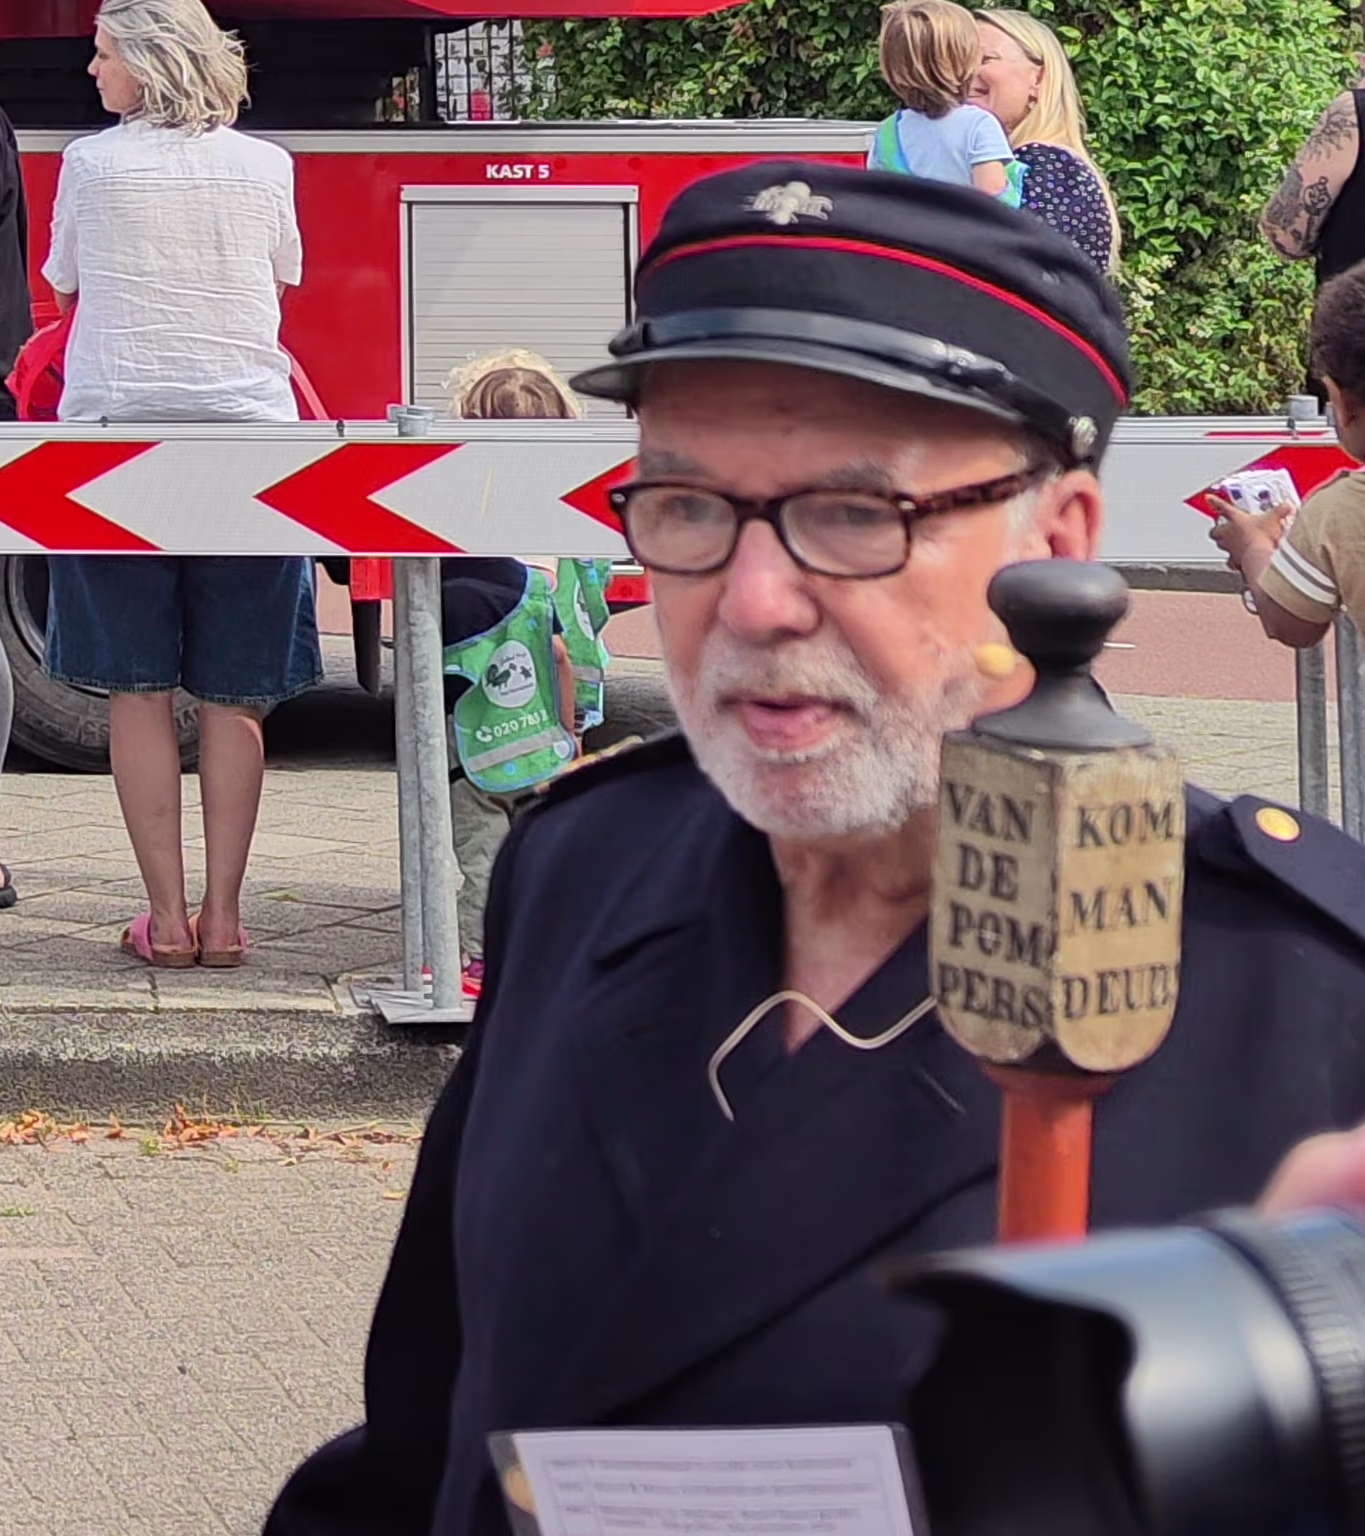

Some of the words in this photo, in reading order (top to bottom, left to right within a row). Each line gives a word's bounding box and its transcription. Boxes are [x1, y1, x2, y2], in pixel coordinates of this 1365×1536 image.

[486, 164, 534, 179] KAST
[538, 164, 550, 179] 5
[946, 782, 1034, 844] VAN
[1077, 799, 1175, 848] KOM
[959, 843, 1017, 902] DE
[1069, 876, 1174, 939] MAN
